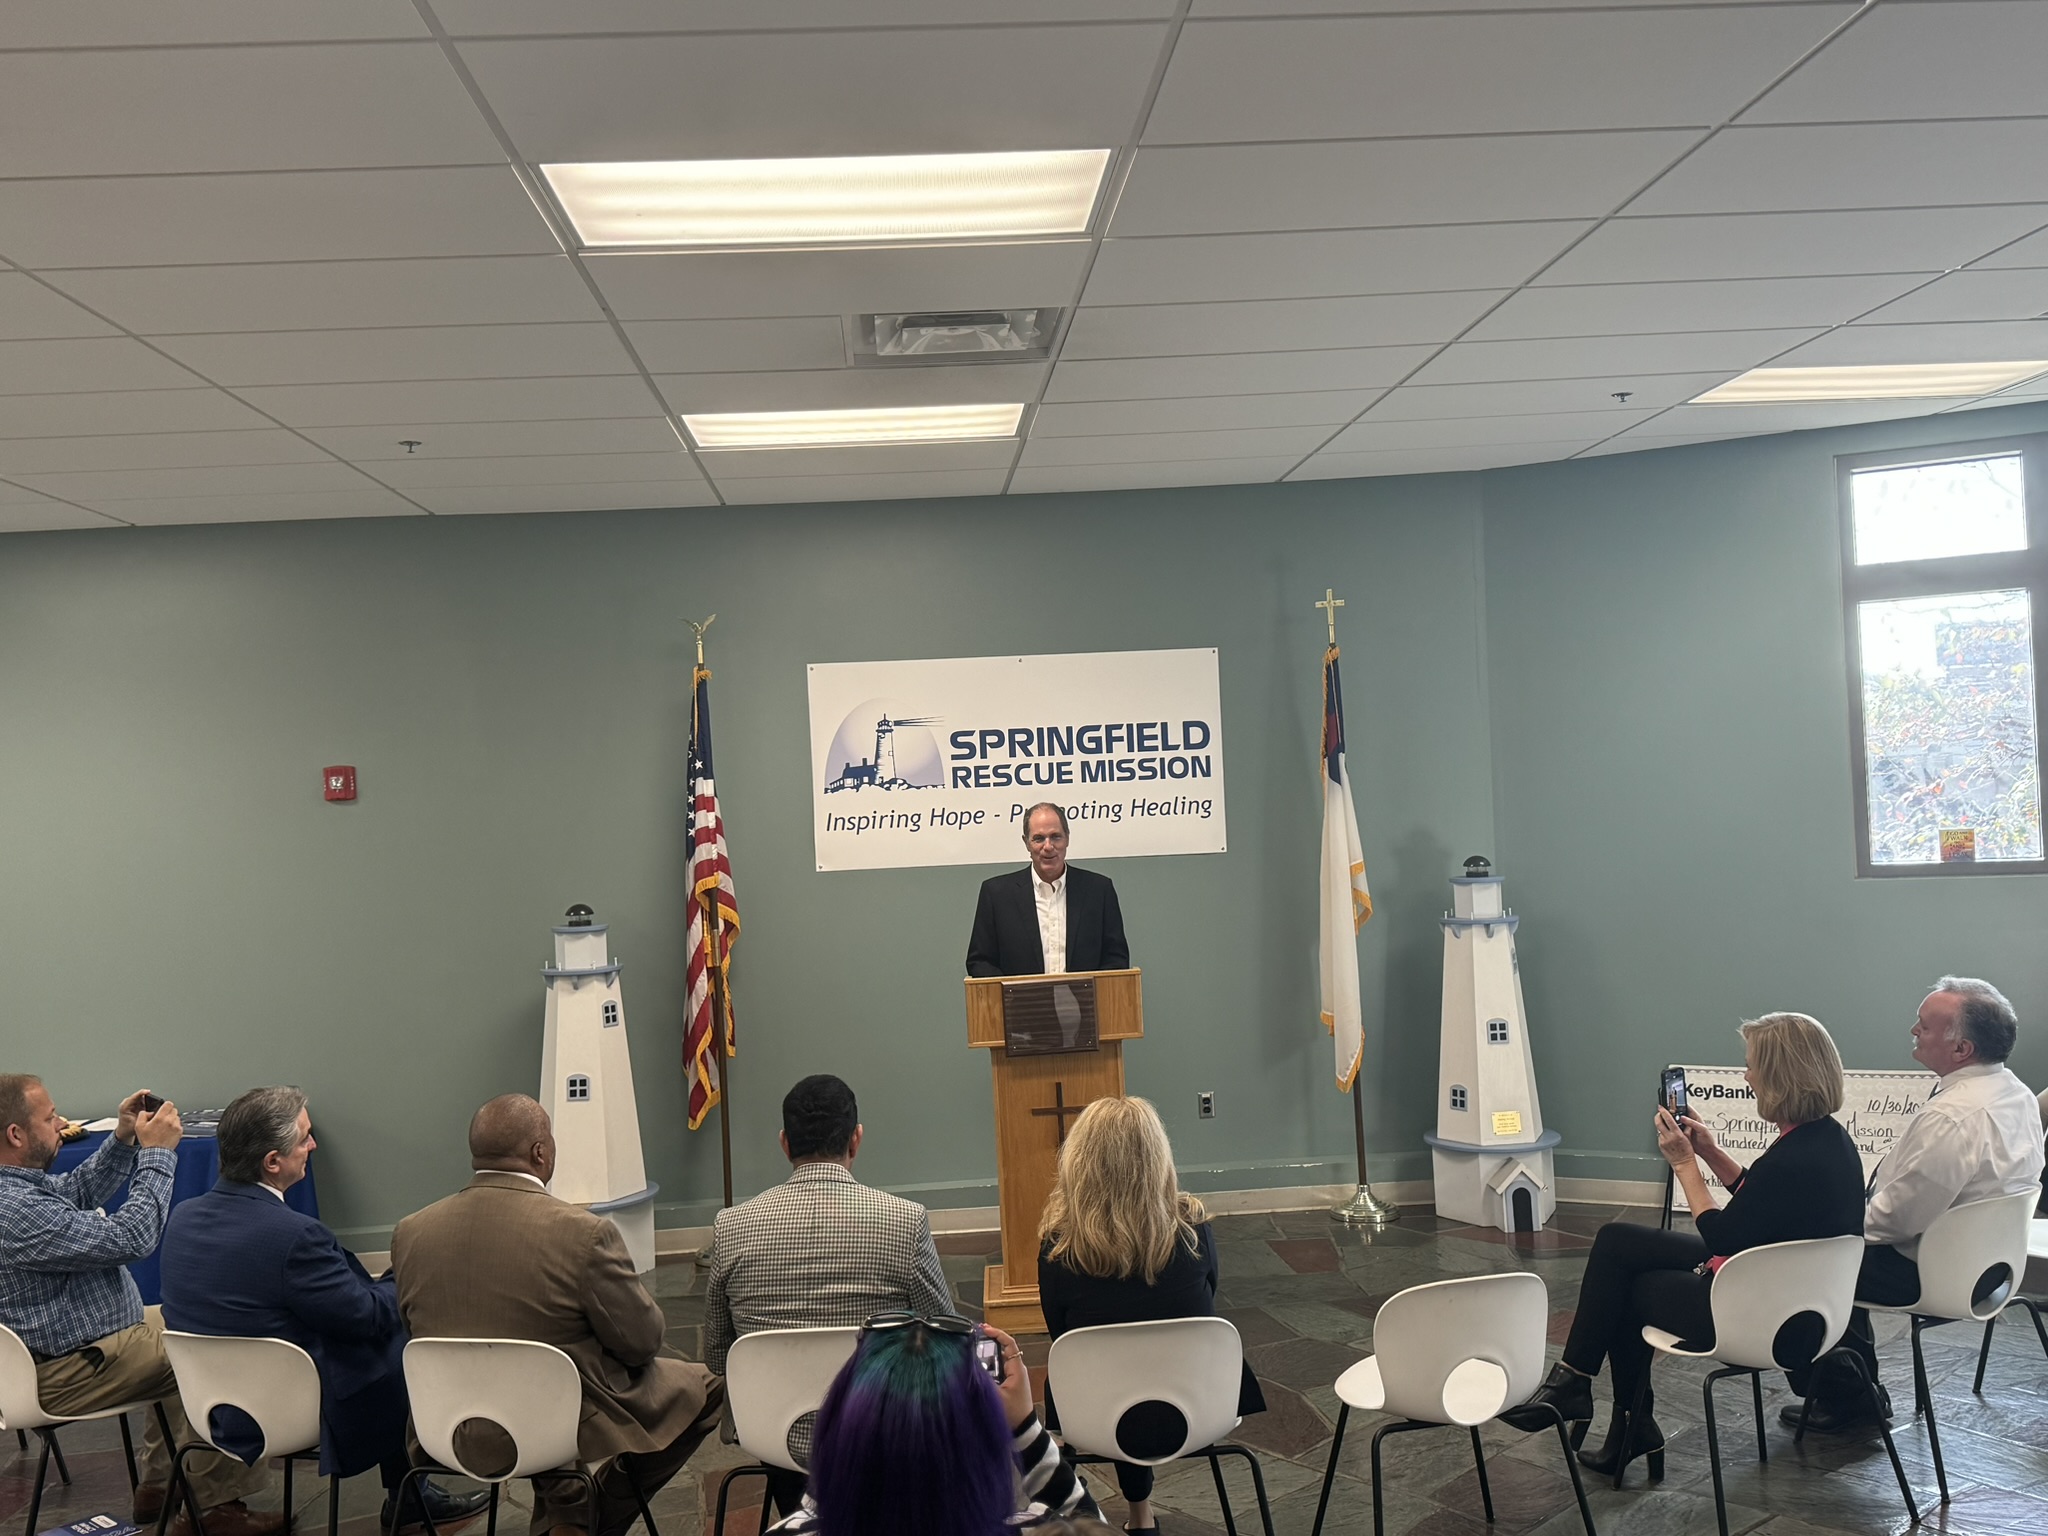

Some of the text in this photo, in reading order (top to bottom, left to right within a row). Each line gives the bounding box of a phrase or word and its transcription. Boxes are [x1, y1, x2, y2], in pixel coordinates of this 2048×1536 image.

[949, 720, 1211, 761] SPRINGFIELD
[951, 755, 1212, 790] RESCUE MISSION
[826, 809, 922, 835] Inspiring
[929, 807, 986, 830] Hope
[1009, 800, 1123, 823] Poting
[1130, 796, 1213, 819] Healing
[1686, 1083, 1756, 1101] KeyBank
[1867, 1094, 1925, 1116] 10/30/20
[1712, 1111, 1893, 1140] Springfie Mission
[1717, 1132, 1768, 1150] Hundred
